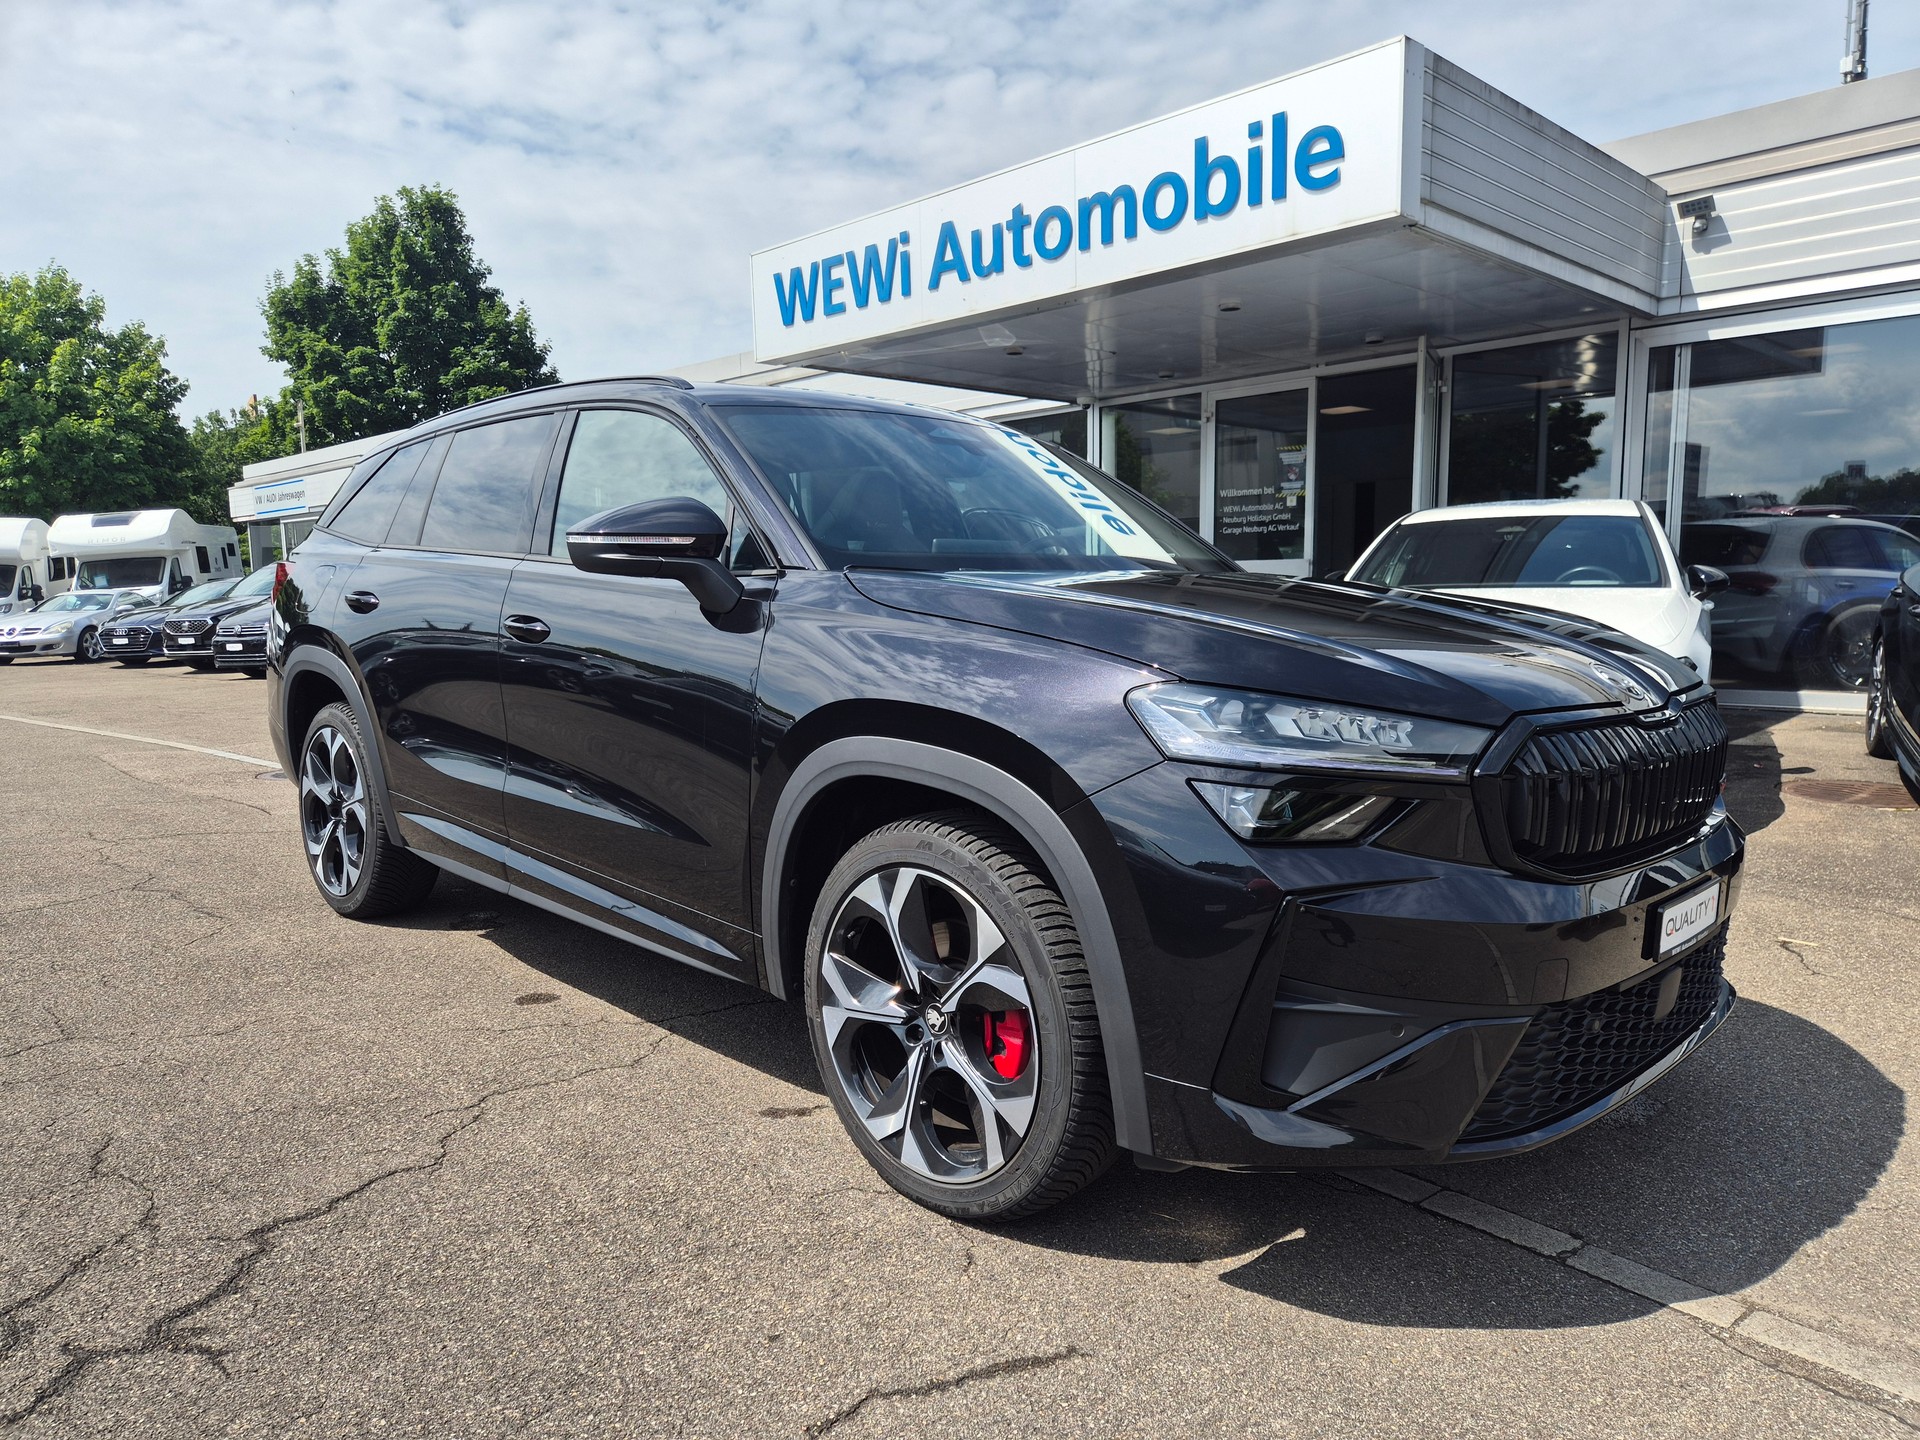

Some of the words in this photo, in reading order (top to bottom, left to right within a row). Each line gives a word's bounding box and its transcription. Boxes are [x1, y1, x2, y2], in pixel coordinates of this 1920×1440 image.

[773, 230, 912, 328] WEWi
[928, 110, 1345, 292] Automobile
[255, 495, 263, 504] VW
[266, 492, 277, 503] AUDI
[277, 490, 305, 502] Jahreswagen
[1219, 488, 1262, 498] Willkommen
[1263, 486, 1275, 495] bei
[1241, 504, 1274, 512] Automobile
[1274, 502, 1284, 510] AG
[1223, 516, 1247, 524] Neuburg
[1247, 514, 1272, 523] Holidays
[1272, 512, 1291, 521] GmbH
[1223, 526, 1242, 535] Garage
[1243, 525, 1268, 534] Neuburg
[1277, 522, 1299, 531] Verkauf
[915, 839, 1028, 936] MAXXIS
[1666, 897, 1711, 937] QUALITY
[974, 1137, 1055, 1213] PREMITRA
